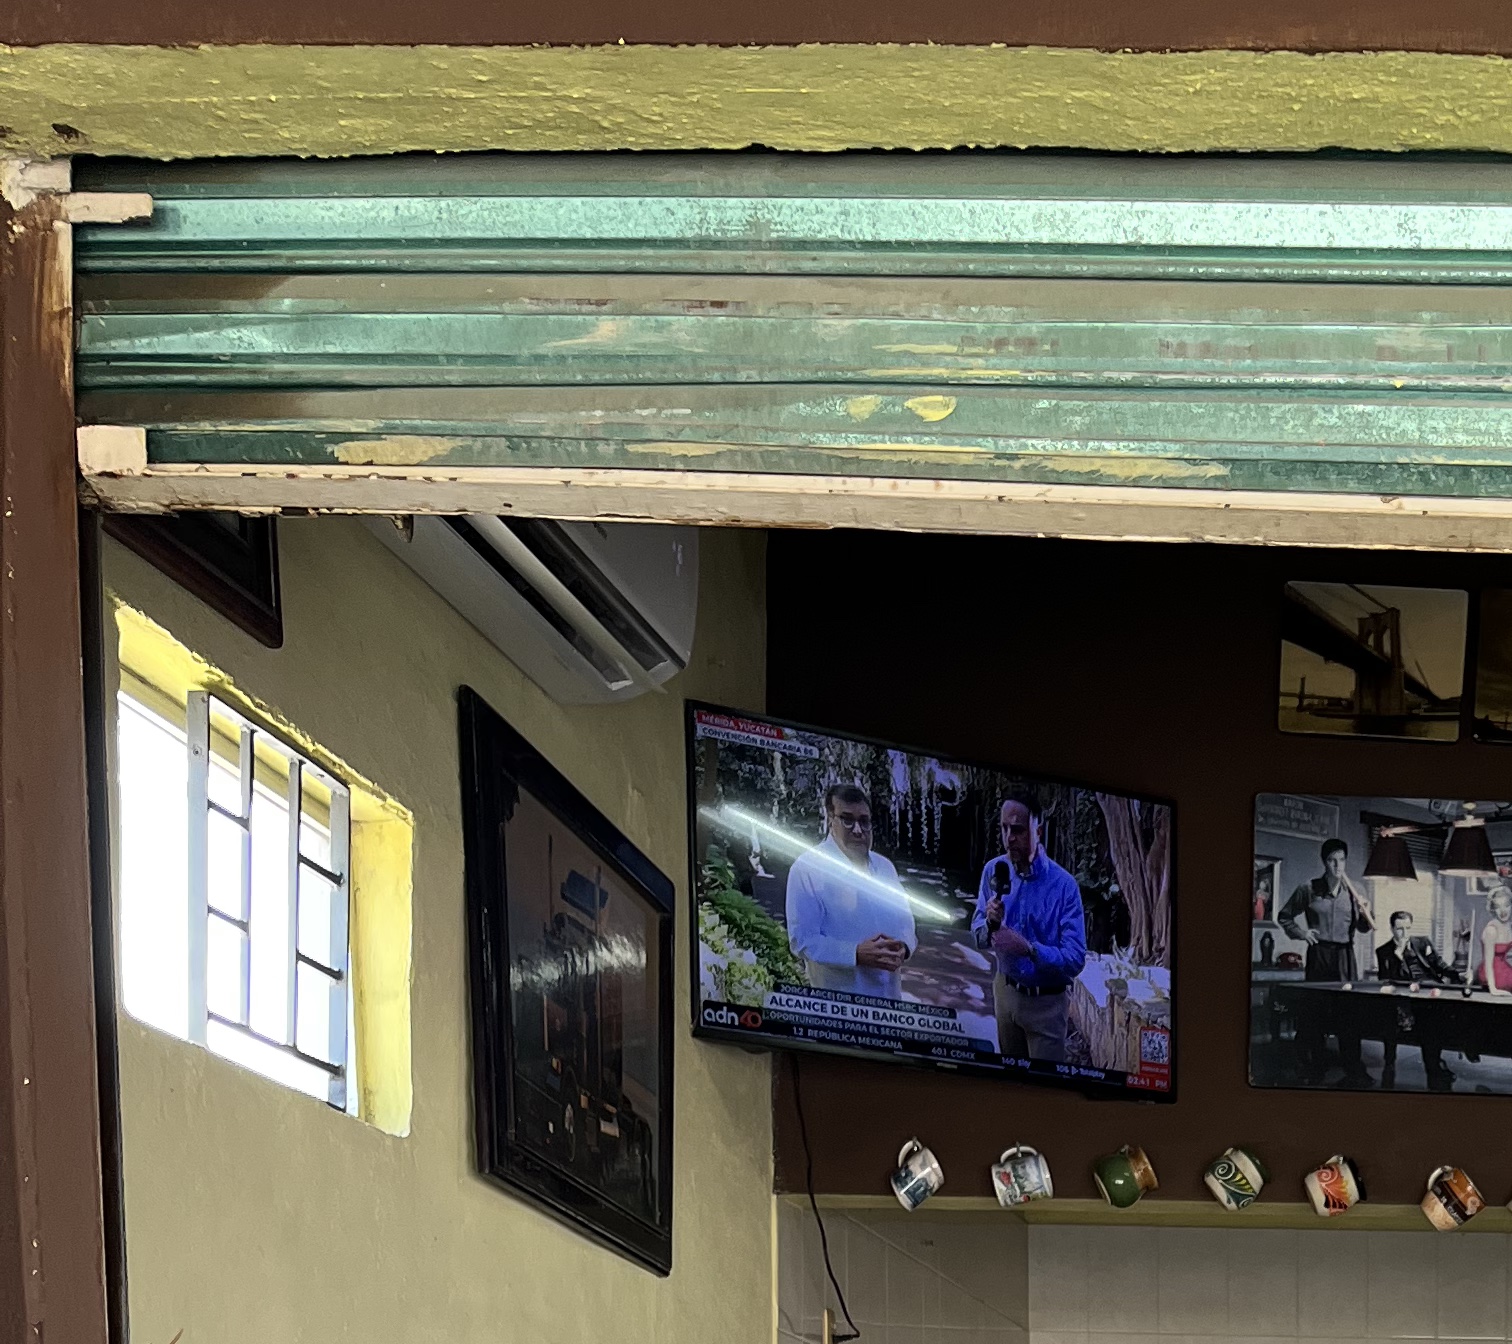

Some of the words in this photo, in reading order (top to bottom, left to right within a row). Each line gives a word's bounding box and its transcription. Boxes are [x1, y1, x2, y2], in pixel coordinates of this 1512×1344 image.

[702, 726, 758, 745] CONVENCIÓN
[759, 739, 802, 754] BANCARIA
[738, 720, 778, 737] YUCATÁN
[769, 995, 828, 1013] ALCANCE
[831, 1004, 848, 1016] DE
[851, 1007, 869, 1020] UN
[871, 1010, 916, 1026] BANCO
[917, 1017, 966, 1034] GLOBAL
[780, 984, 809, 997] JORGE
[854, 996, 893, 1009] GENERAL
[918, 1005, 950, 1017] MÉXICO
[769, 1011, 844, 1029] OPORTUNIDADES
[844, 1021, 868, 1033] PARA
[869, 1025, 879, 1035] EL
[880, 1027, 914, 1040] SECTOR
[914, 1032, 969, 1047] EXPORTADOR
[807, 1027, 857, 1044] REPÚBLICA
[950, 1050, 976, 1060] CDMX
[1155, 1079, 1169, 1091] PM
